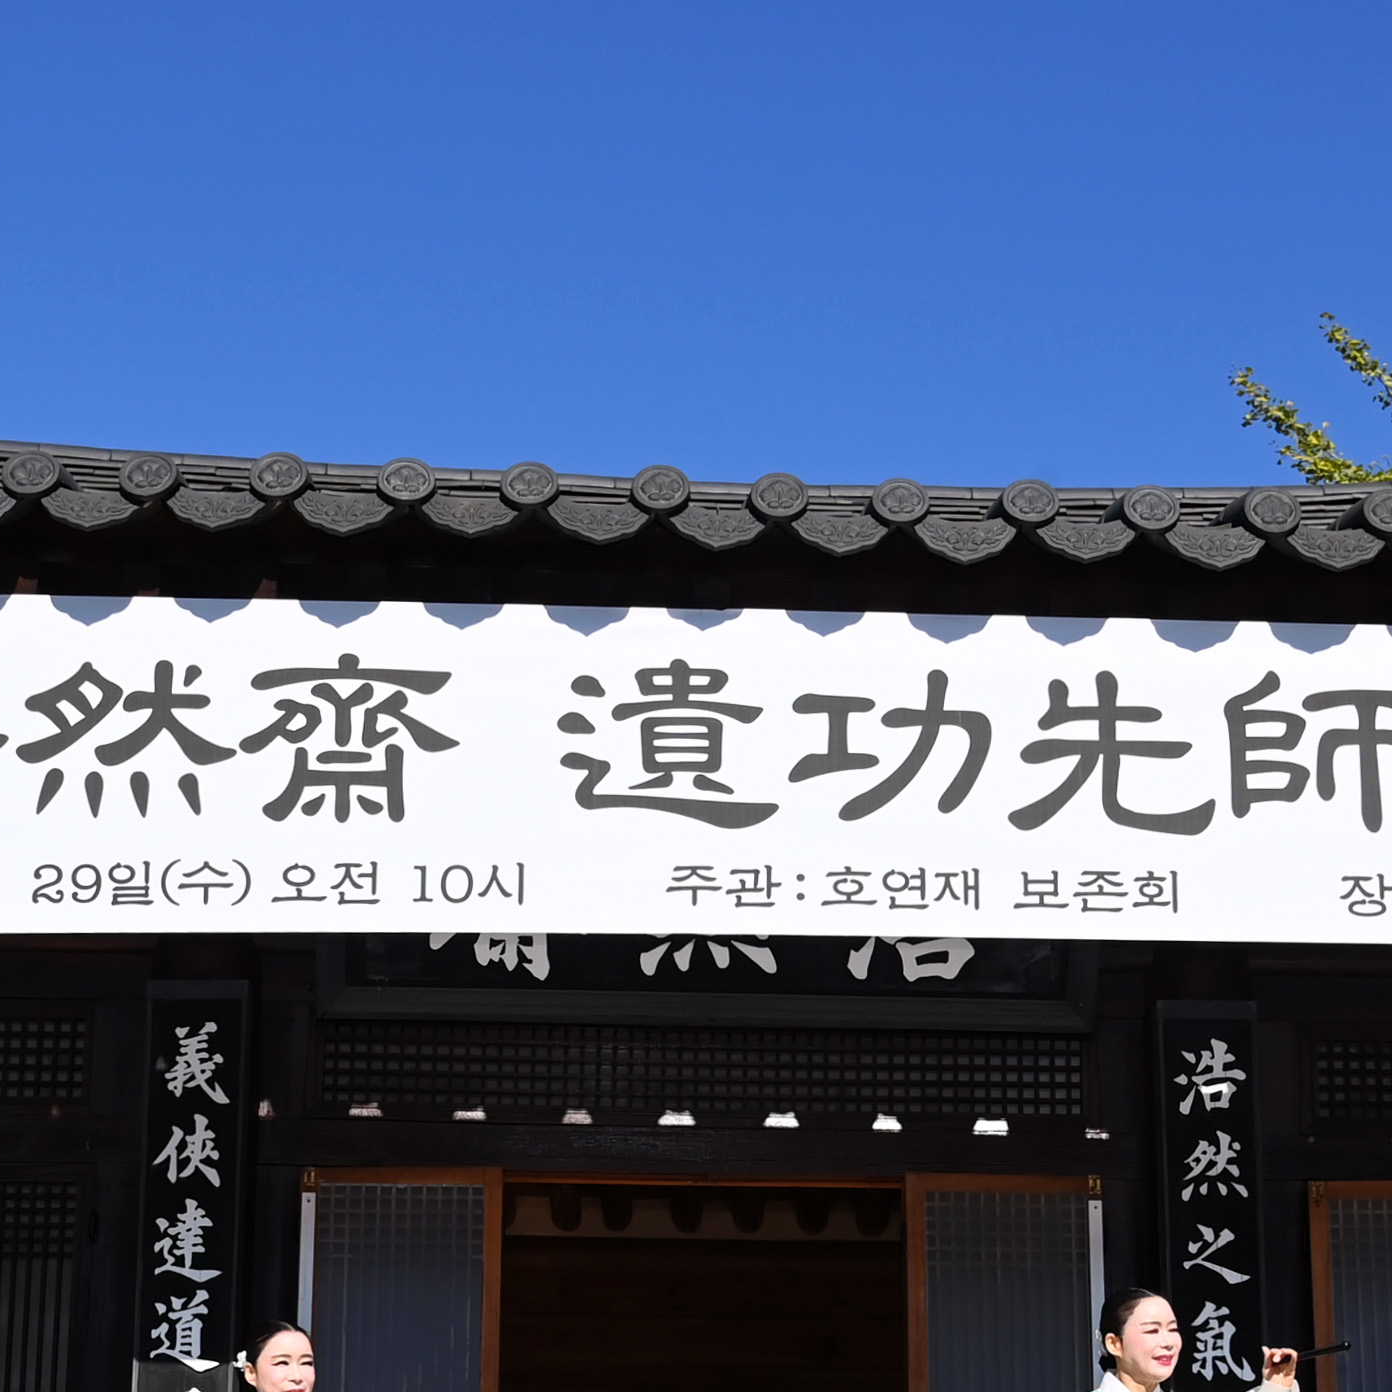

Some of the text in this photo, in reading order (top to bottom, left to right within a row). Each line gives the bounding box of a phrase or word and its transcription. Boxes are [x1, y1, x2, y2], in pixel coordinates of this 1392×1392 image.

[33, 860, 250, 905] 29일(수)
[272, 862, 379, 904] 오전
[414, 863, 523, 905] 10시
[1014, 871, 1177, 913] 보존회
